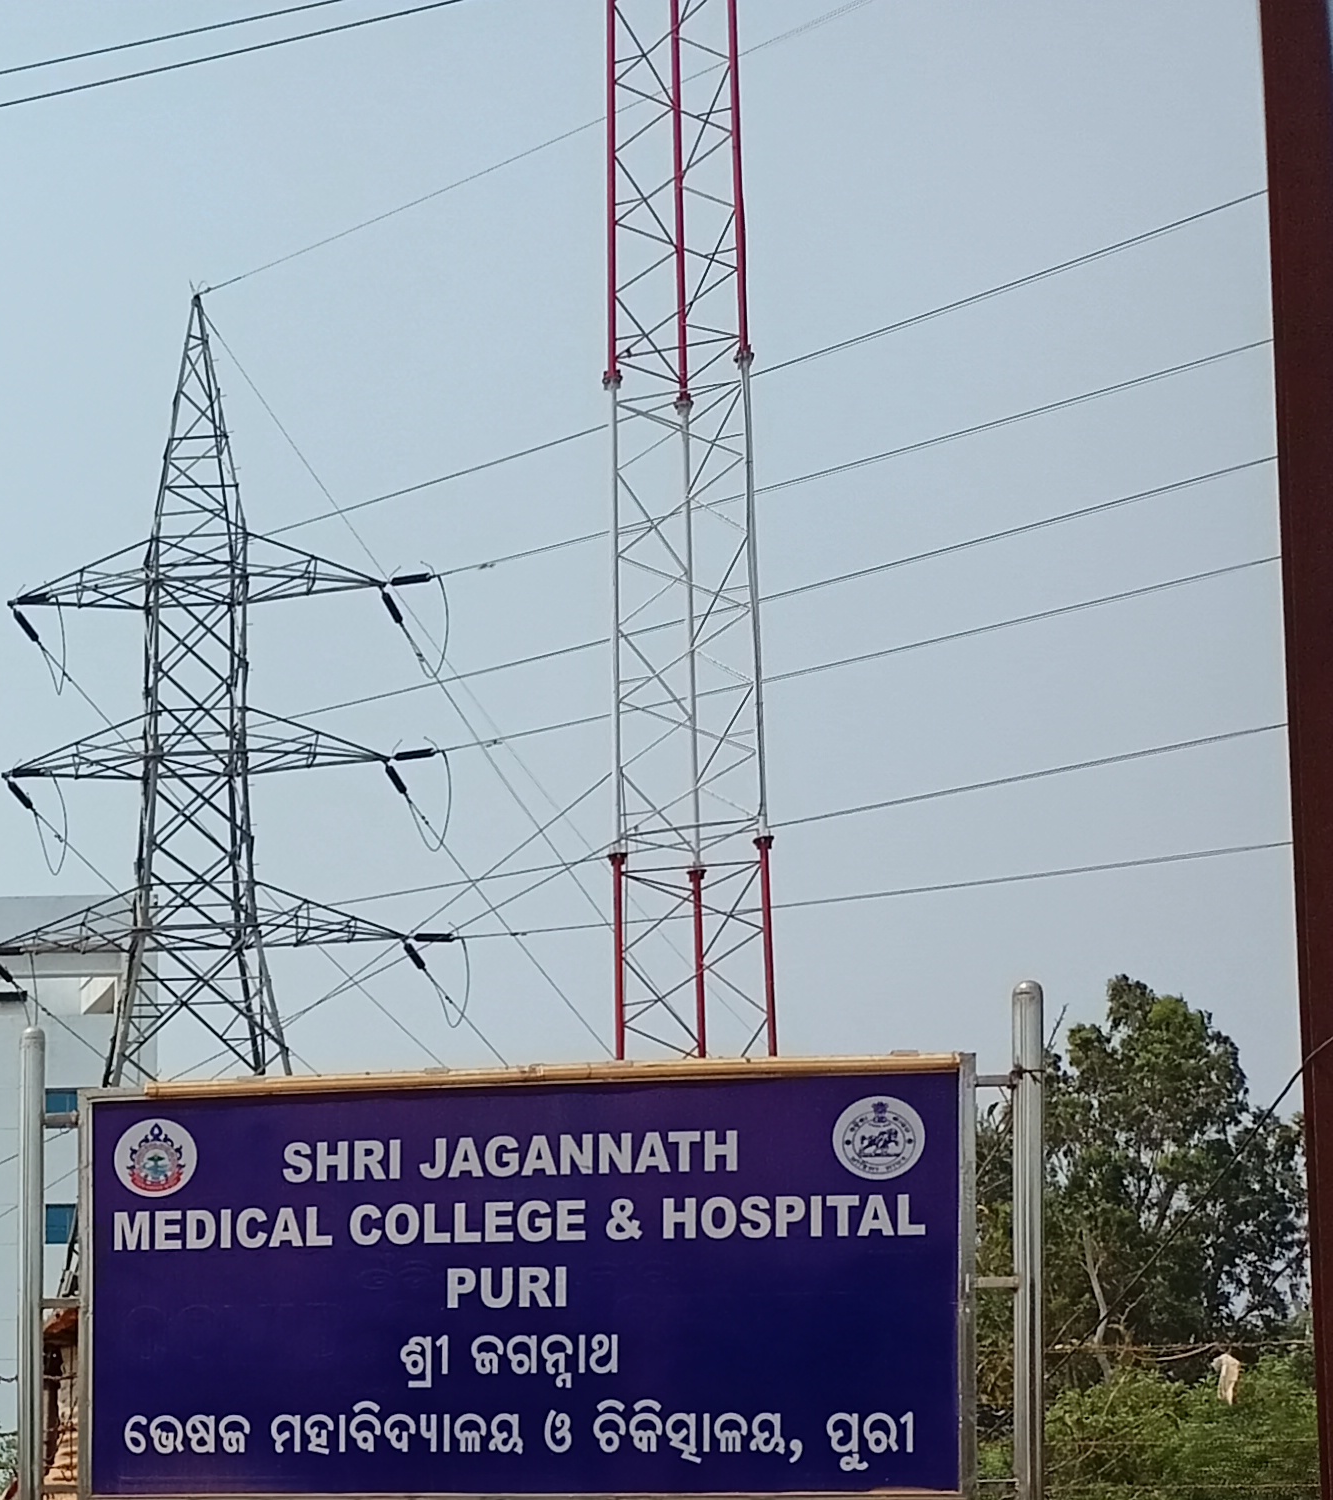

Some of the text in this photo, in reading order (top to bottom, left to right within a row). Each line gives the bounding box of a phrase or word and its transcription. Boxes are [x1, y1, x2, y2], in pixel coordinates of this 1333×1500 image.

[282, 1129, 739, 1184] SHRI JAGANNATH
[112, 1193, 927, 1251] MEDICAL COLLEGE & HOSPITAL
[446, 1265, 568, 1309] PURI
[399, 1333, 619, 1389] ଶ୍ରୀ ଜଗନ୍ନାଥ
[124, 1413, 251, 1455] ଭେଷଜ
[270, 1400, 525, 1456] ମହାବିଦ୍ୟାଳୟ
[543, 1408, 573, 1454] ଓ
[825, 1410, 915, 1472] ପୁରୀ
